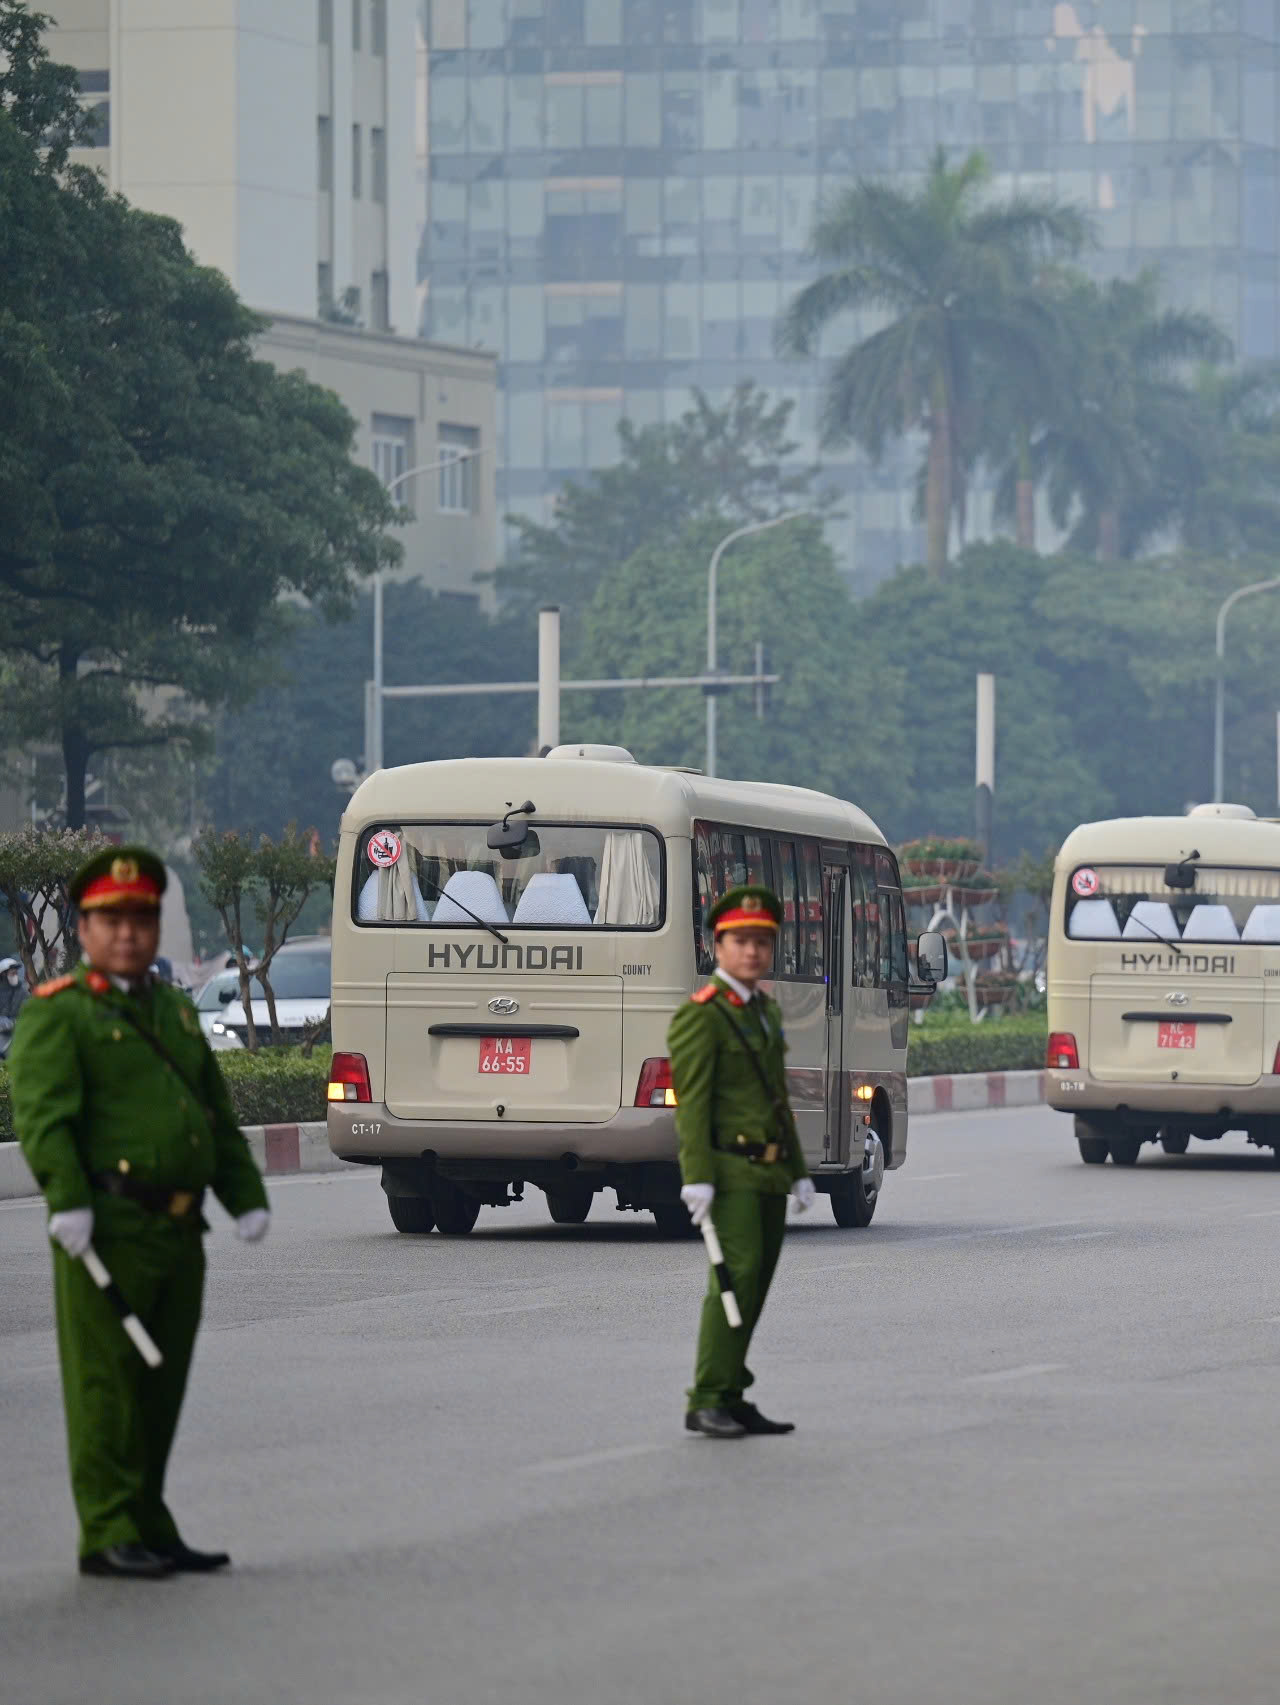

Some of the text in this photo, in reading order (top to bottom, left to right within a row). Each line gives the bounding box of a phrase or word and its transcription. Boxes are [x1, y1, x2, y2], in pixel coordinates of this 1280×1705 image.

[428, 943, 584, 970] HYUNDAI
[1121, 953, 1235, 974] HYUNDAI
[622, 964, 652, 976] COUNTY
[495, 1037, 513, 1055] KA
[481, 1056, 525, 1073] 66-55
[351, 1123, 382, 1135] CT-17
